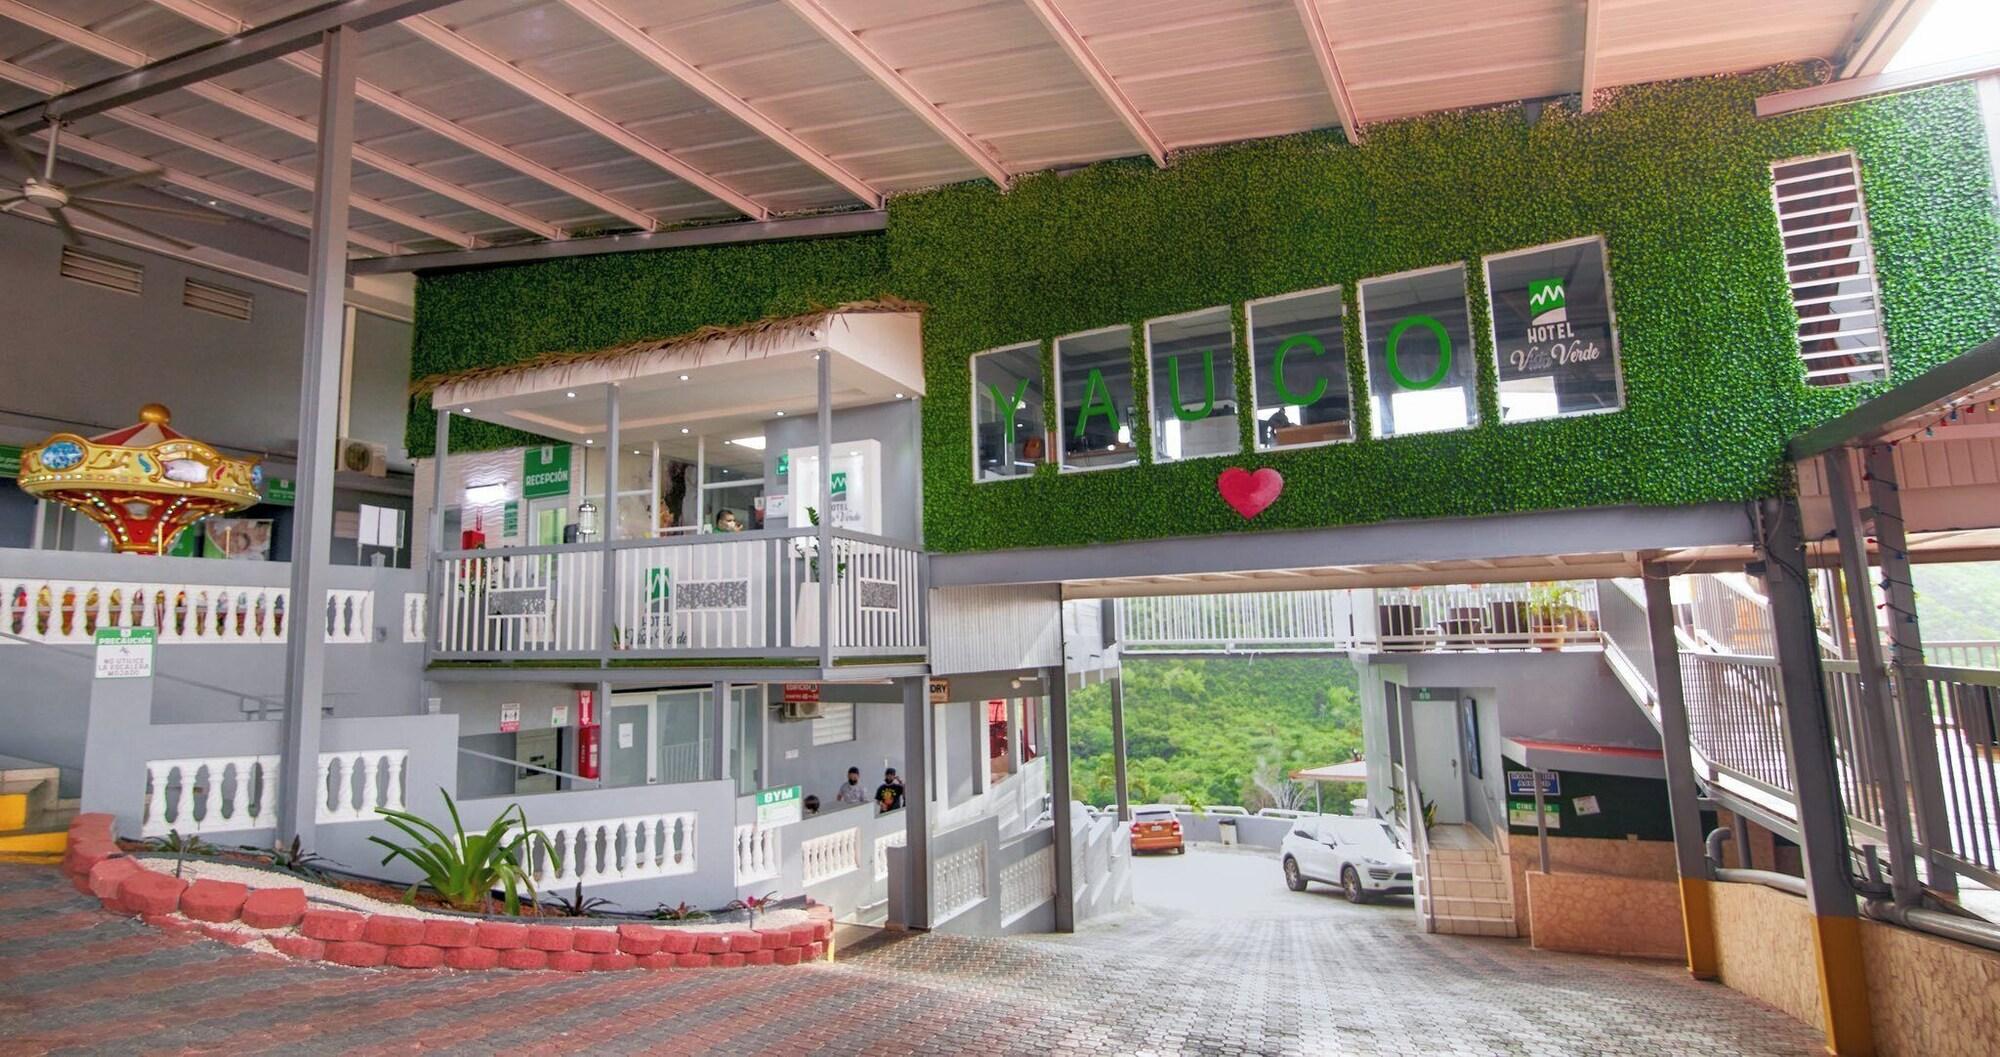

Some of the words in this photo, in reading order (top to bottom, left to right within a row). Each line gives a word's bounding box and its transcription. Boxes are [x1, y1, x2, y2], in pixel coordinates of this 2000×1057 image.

[1527, 322, 1575, 344] HOTEL
[1551, 340, 1600, 365] Verde
[988, 314, 1453, 444] YAUCO
[526, 468, 569, 486] RECEPCIÓN
[830, 503, 849, 512] OTEL
[641, 615, 672, 627] HOTL
[99, 635, 152, 645] PRECAUCIÓN
[930, 684, 946, 694] DRY
[764, 788, 793, 803] GYM
